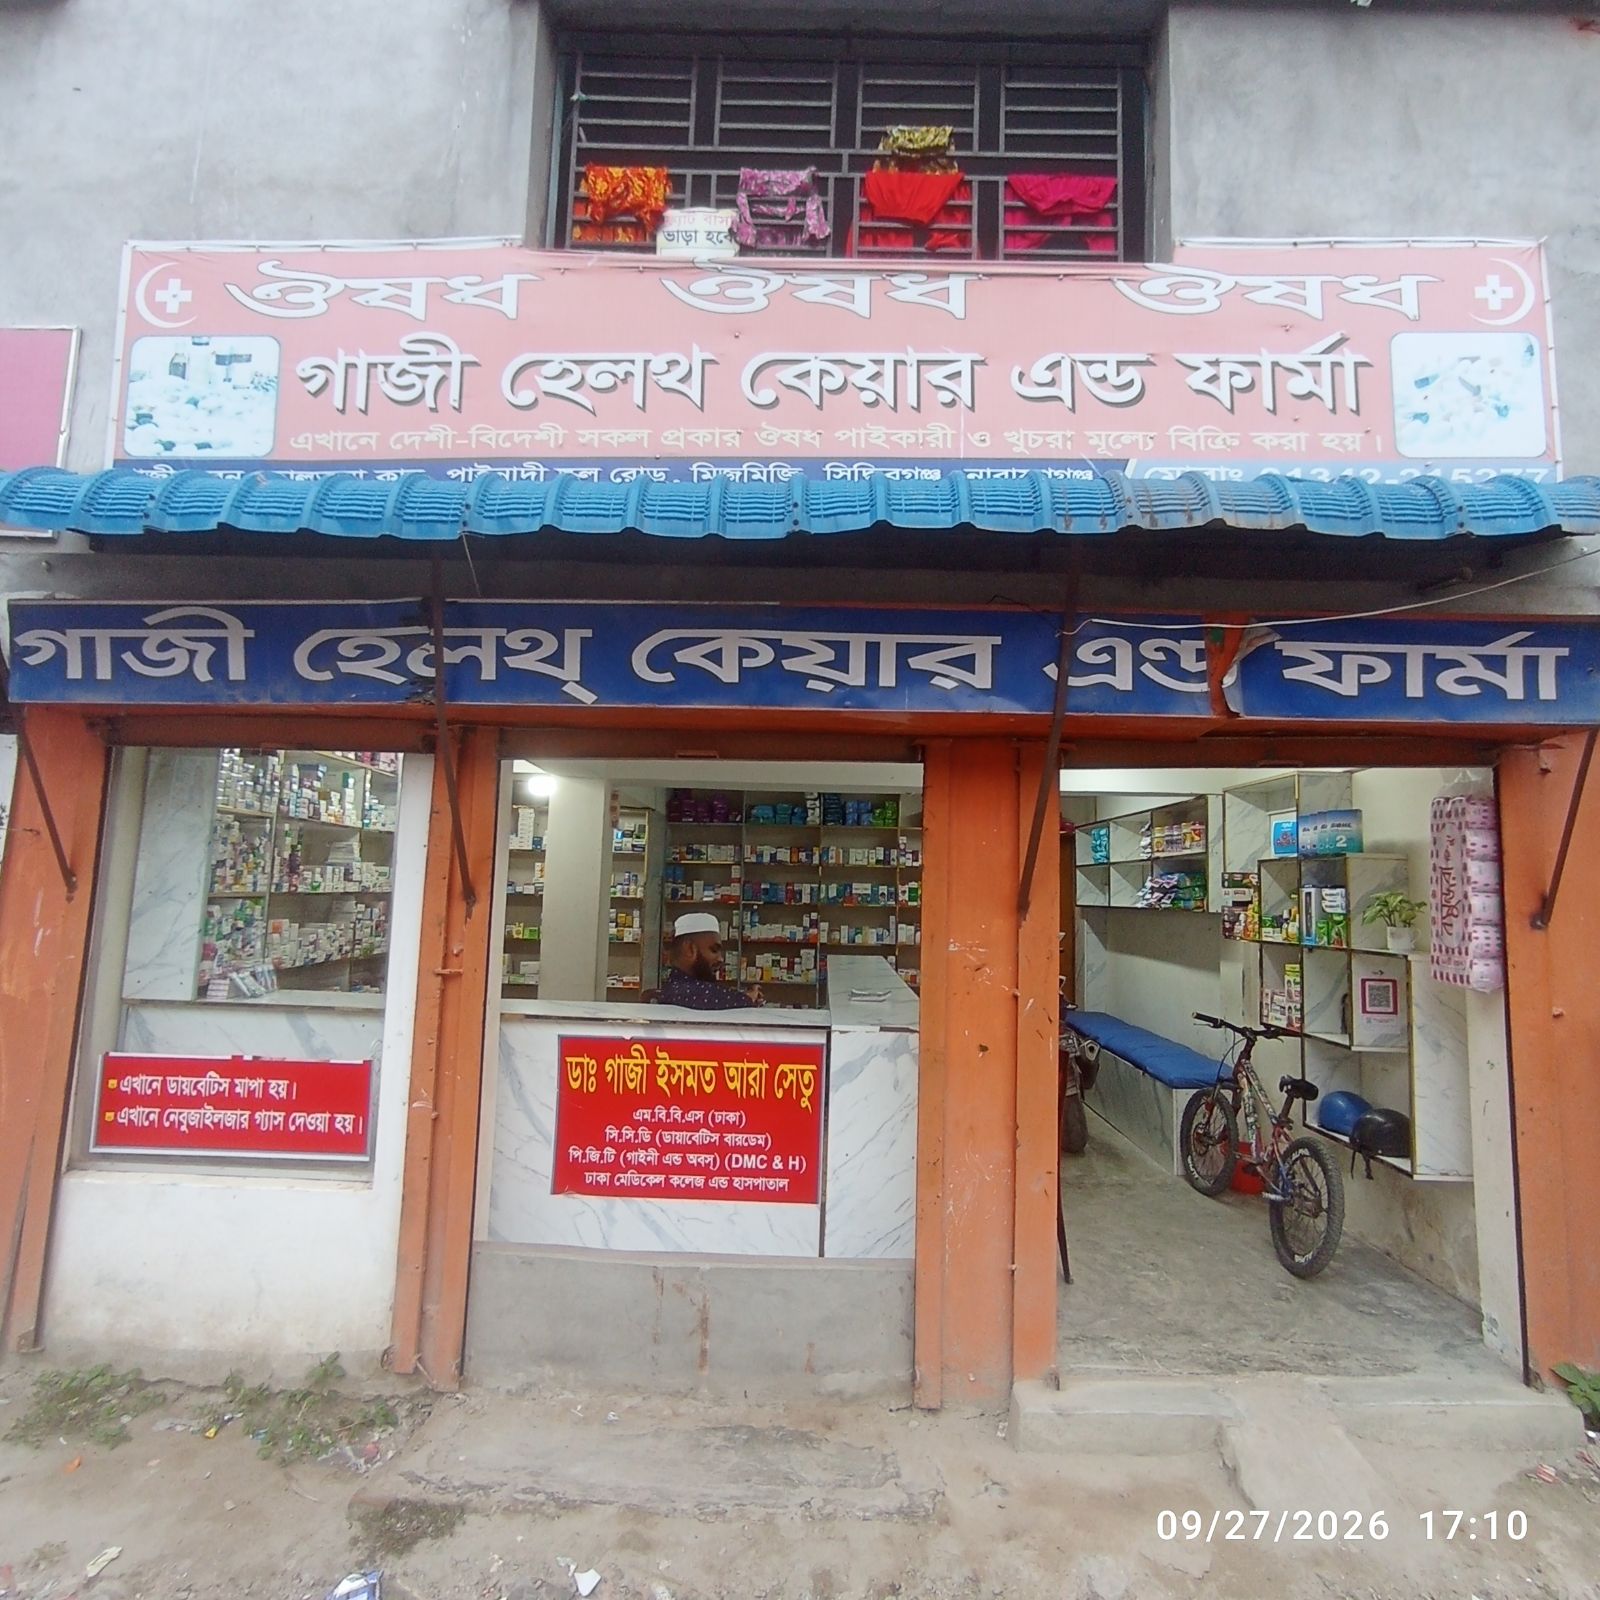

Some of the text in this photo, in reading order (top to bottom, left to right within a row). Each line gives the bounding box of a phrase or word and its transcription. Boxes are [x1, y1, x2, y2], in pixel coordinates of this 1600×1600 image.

[662, 229, 698, 246] ভাড়া
[224, 259, 544, 321] ঔষধ
[661, 256, 988, 320] ঔষধ
[296, 331, 1376, 415] গাজী হেলথ কেয়ার এন্ড ফার্মা
[290, 429, 381, 451] এখানে
[389, 422, 568, 450] দেশী-বিদেশী
[577, 428, 652, 449] সকল
[661, 426, 743, 449] প্রকার
[754, 421, 822, 449] ঔষধ
[834, 422, 957, 449] পাইকারী
[967, 432, 991, 449] ও
[1003, 428, 1075, 454] খুচরা
[1085, 429, 1156, 456] মূল্যে
[1166, 425, 1241, 452] বিক্রি
[1250, 430, 1309, 452] করা
[13, 606, 255, 682] গাজী
[631, 628, 1002, 693] কেয়ার
[1274, 631, 1570, 700] ফার্মা
[120, 1073, 163, 1096] এখানে
[233, 1076, 265, 1098] মাপা
[565, 1043, 818, 1114] ডাঃ গাজী ইসমত আরা সেতু
[117, 1105, 161, 1128] এখানে
[254, 1109, 286, 1132] গ্যাস
[288, 1111, 332, 1133] দেওয়া
[633, 1105, 746, 1128] এম.বি.বি.এস (ঢাকা)
[605, 1125, 772, 1151] সি.সি.ডি (ডায়াবেটিস বারডেম)
[568, 1145, 617, 1164] পি.জি.টি
[620, 1147, 660, 1168] (গাইনী
[724, 1153, 768, 1171] (DMC
[772, 1155, 784, 1170] &
[788, 1155, 807, 1174] H)
[584, 1171, 611, 1187] ঢাকা
[614, 1169, 666, 1188] মেডিকেল
[668, 1174, 706, 1189] কলেজ
[731, 1176, 790, 1192] হাসপাতাল
